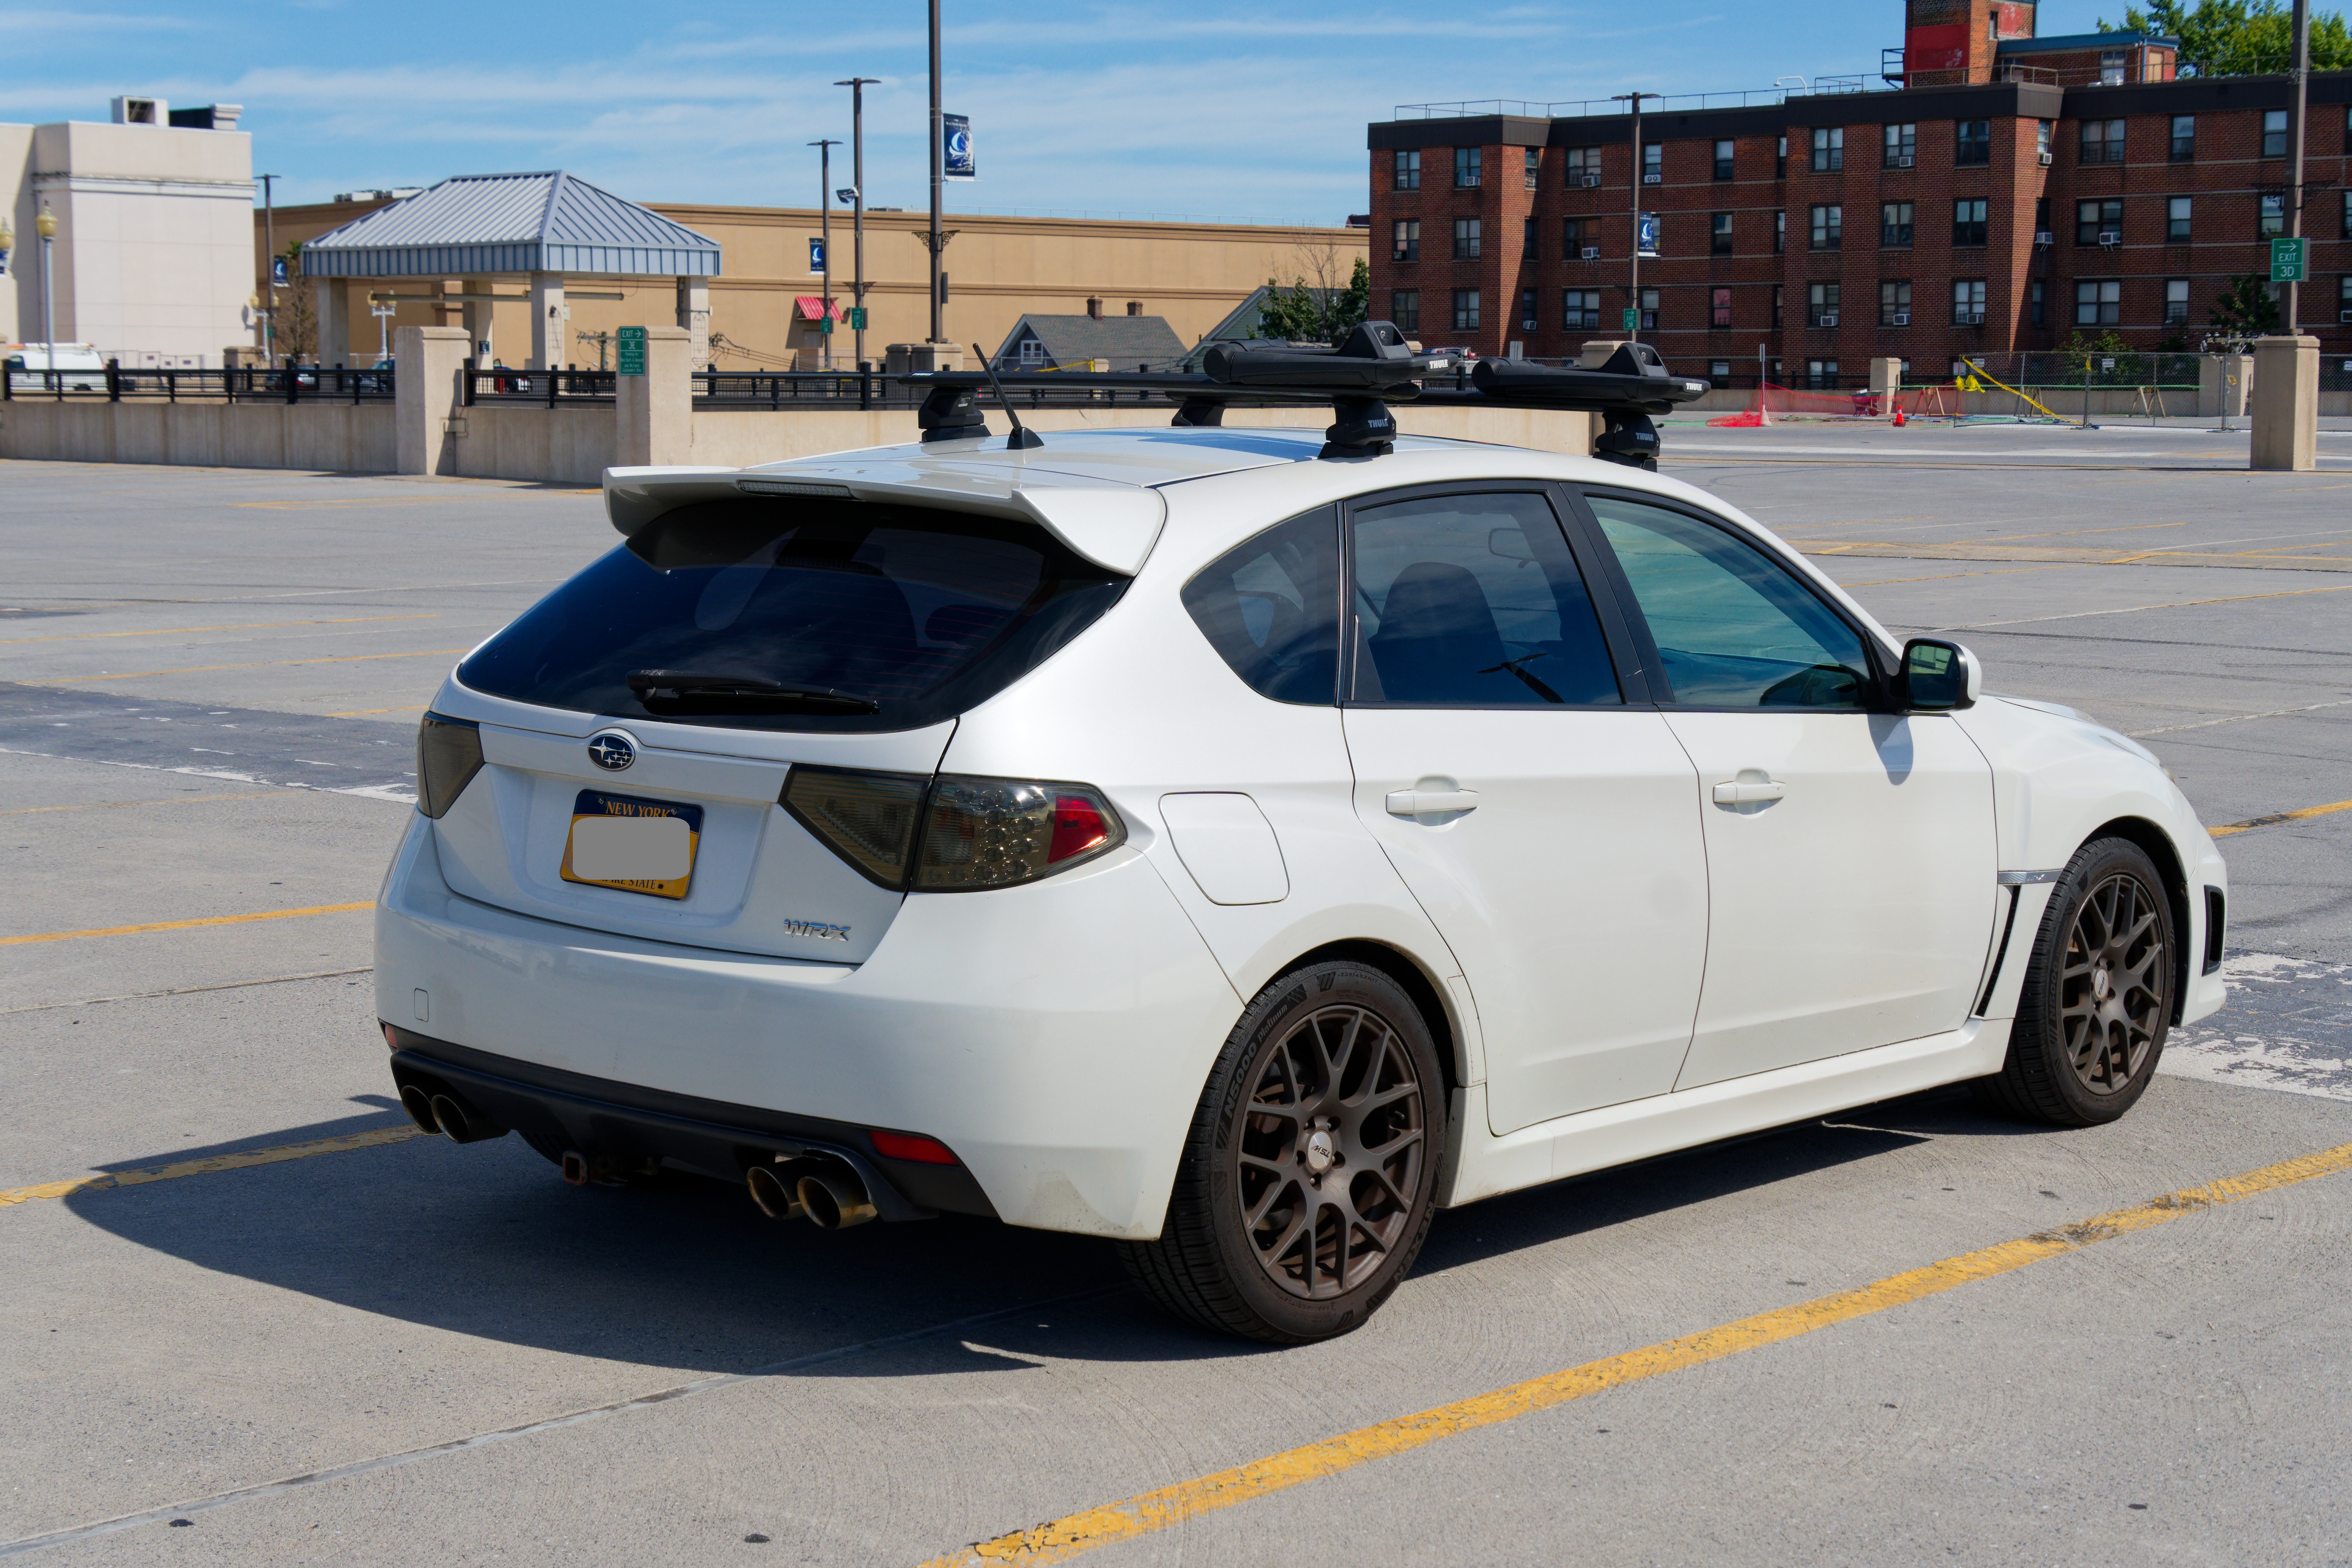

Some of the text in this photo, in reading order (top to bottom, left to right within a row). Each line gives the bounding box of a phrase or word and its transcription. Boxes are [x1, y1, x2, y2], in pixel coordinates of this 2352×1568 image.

[2279, 253, 2297, 262] EXIT
[2281, 266, 2295, 277] 3D
[629, 341, 635, 349] 3E
[1429, 359, 1448, 369] THULE
[1368, 419, 1388, 428] THULE
[1636, 432, 1654, 441] THULE
[605, 801, 671, 817] NEW YORK
[629, 880, 657, 889] STATE
[784, 919, 851, 942] WRX
[1340, 972, 1378, 983] 235/45ZR17
[1224, 1042, 1257, 1119] N5000
[1311, 1145, 1330, 1158] TSW
[1393, 1201, 1434, 1283] NEXEN
